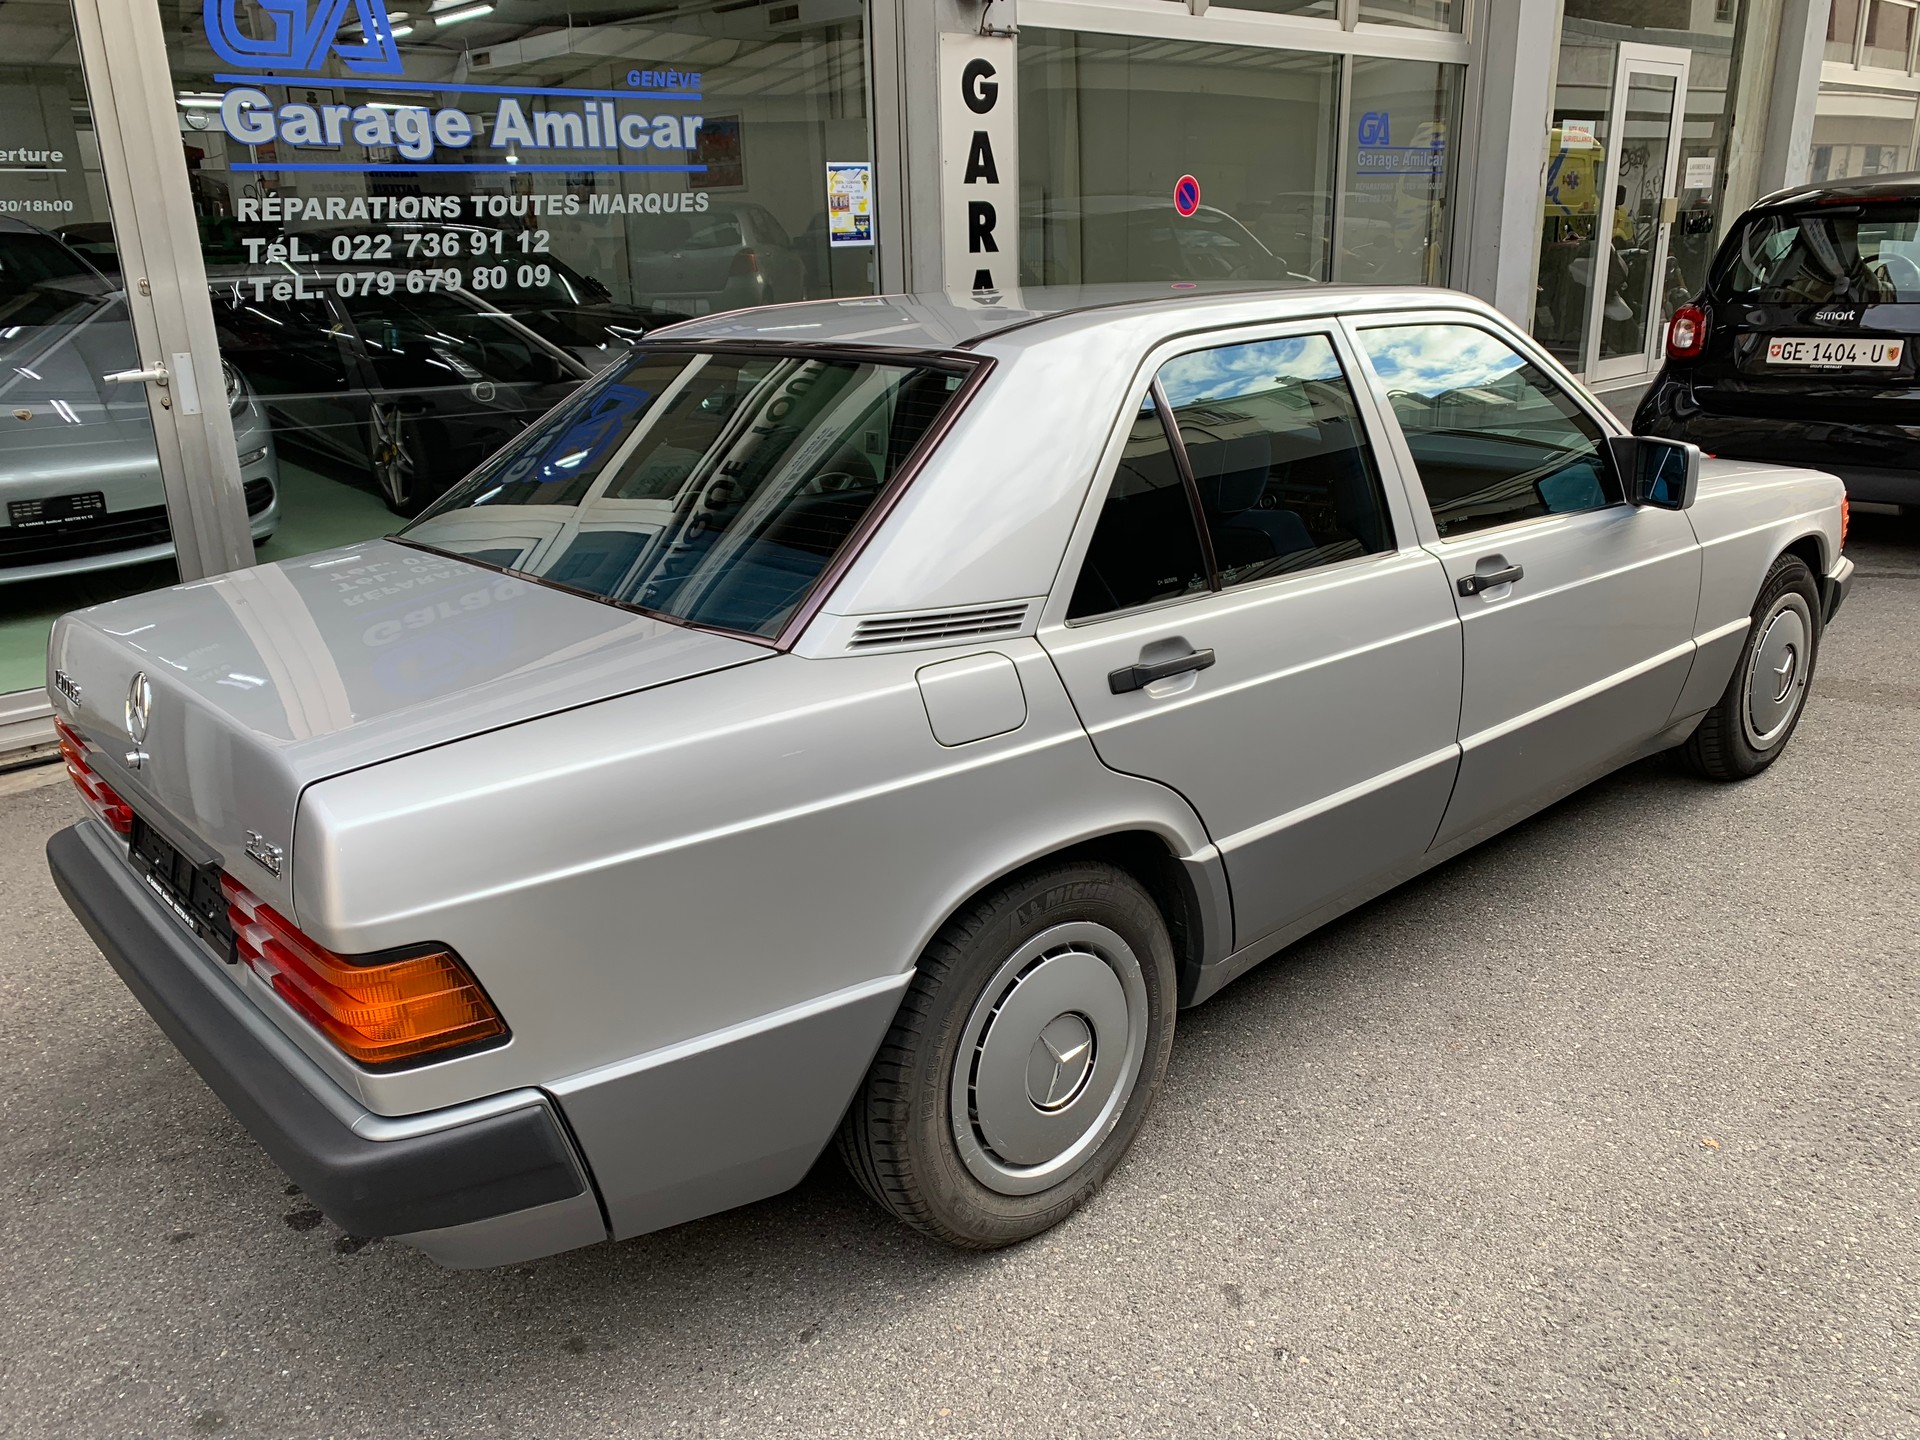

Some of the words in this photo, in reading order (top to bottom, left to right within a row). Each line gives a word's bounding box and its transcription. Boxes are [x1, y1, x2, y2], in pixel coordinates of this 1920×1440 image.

[626, 67, 702, 88] GENÈVE
[220, 87, 474, 161] Garage
[490, 97, 704, 150] Amilcar
[1357, 151, 1399, 170] Garage
[1402, 152, 1445, 167] Amilcar
[237, 191, 461, 222] RÉPARATIONS
[470, 193, 580, 217] TOUTES
[588, 192, 709, 215] MARQUES
[331, 234, 392, 261] 022
[403, 232, 460, 258] 736
[470, 230, 503, 256] 91
[516, 229, 550, 254] 12
[336, 271, 395, 298] 079
[406, 267, 462, 293] 679
[472, 265, 507, 290] 80
[516, 263, 550, 288] 09
[1815, 309, 1856, 320] smart
